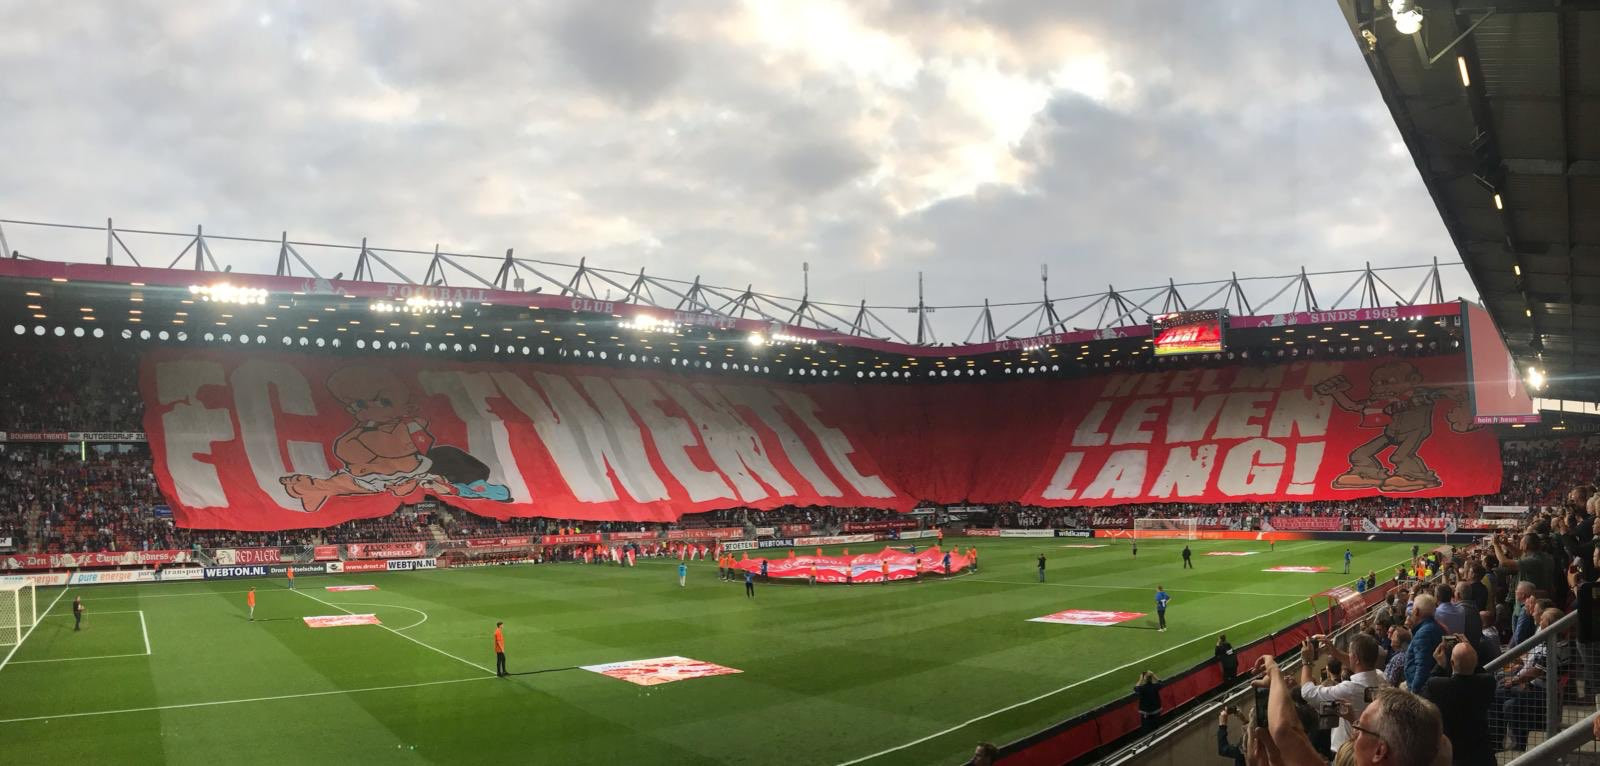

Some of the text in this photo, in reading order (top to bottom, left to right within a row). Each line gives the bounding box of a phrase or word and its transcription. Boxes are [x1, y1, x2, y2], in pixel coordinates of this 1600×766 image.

[386, 284, 614, 314] FOOTBALL CLUB
[673, 310, 737, 329] TWENTE
[1311, 307, 1399, 324] SINDS 1965
[994, 333, 1063, 353] FC TWENTE
[1100, 371, 1221, 398] HEEL
[1071, 396, 1332, 448] LEVEN
[155, 358, 896, 512] FC TWENTE
[1042, 438, 1328, 500] LANG!
[1091, 513, 1129, 526] Ultras
[235, 549, 280, 562] RED ALERT
[388, 560, 437, 570] WEBTON.NL
[78, 574, 98, 583] pure
[100, 571, 133, 583] energie
[206, 566, 266, 577] WEBTON.NL
